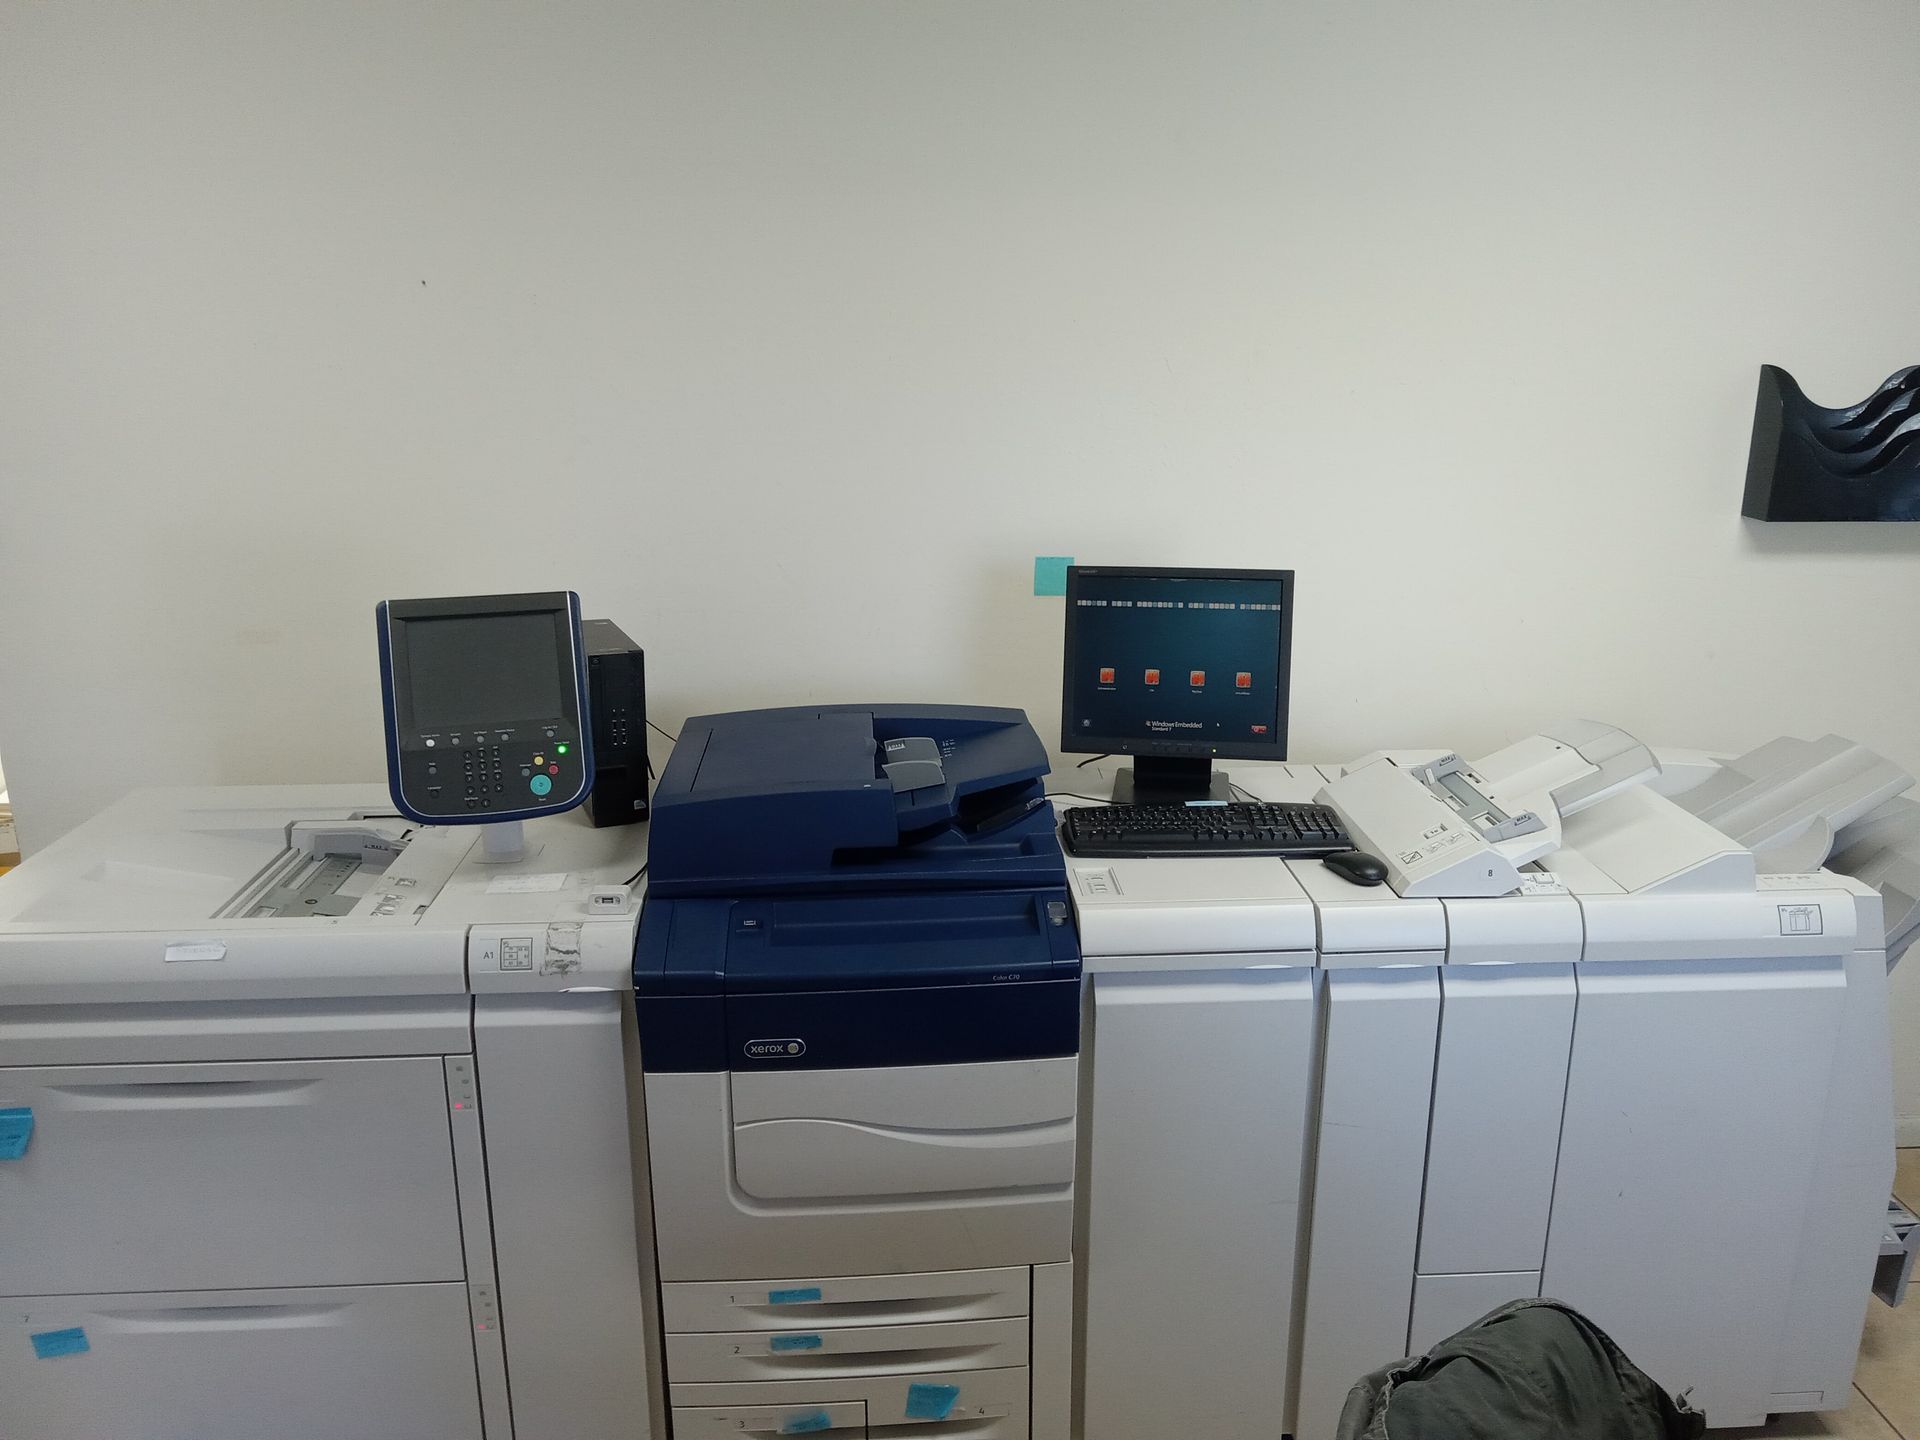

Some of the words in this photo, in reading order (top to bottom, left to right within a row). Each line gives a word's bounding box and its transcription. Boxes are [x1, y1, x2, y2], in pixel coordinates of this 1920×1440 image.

[1487, 869, 1493, 877] 8
[483, 951, 494, 960] A1
[750, 1044, 784, 1054] xerox
[730, 1295, 735, 1303] 1
[734, 1346, 740, 1354] 2
[978, 1407, 985, 1415] 4
[740, 1421, 745, 1429] 3
